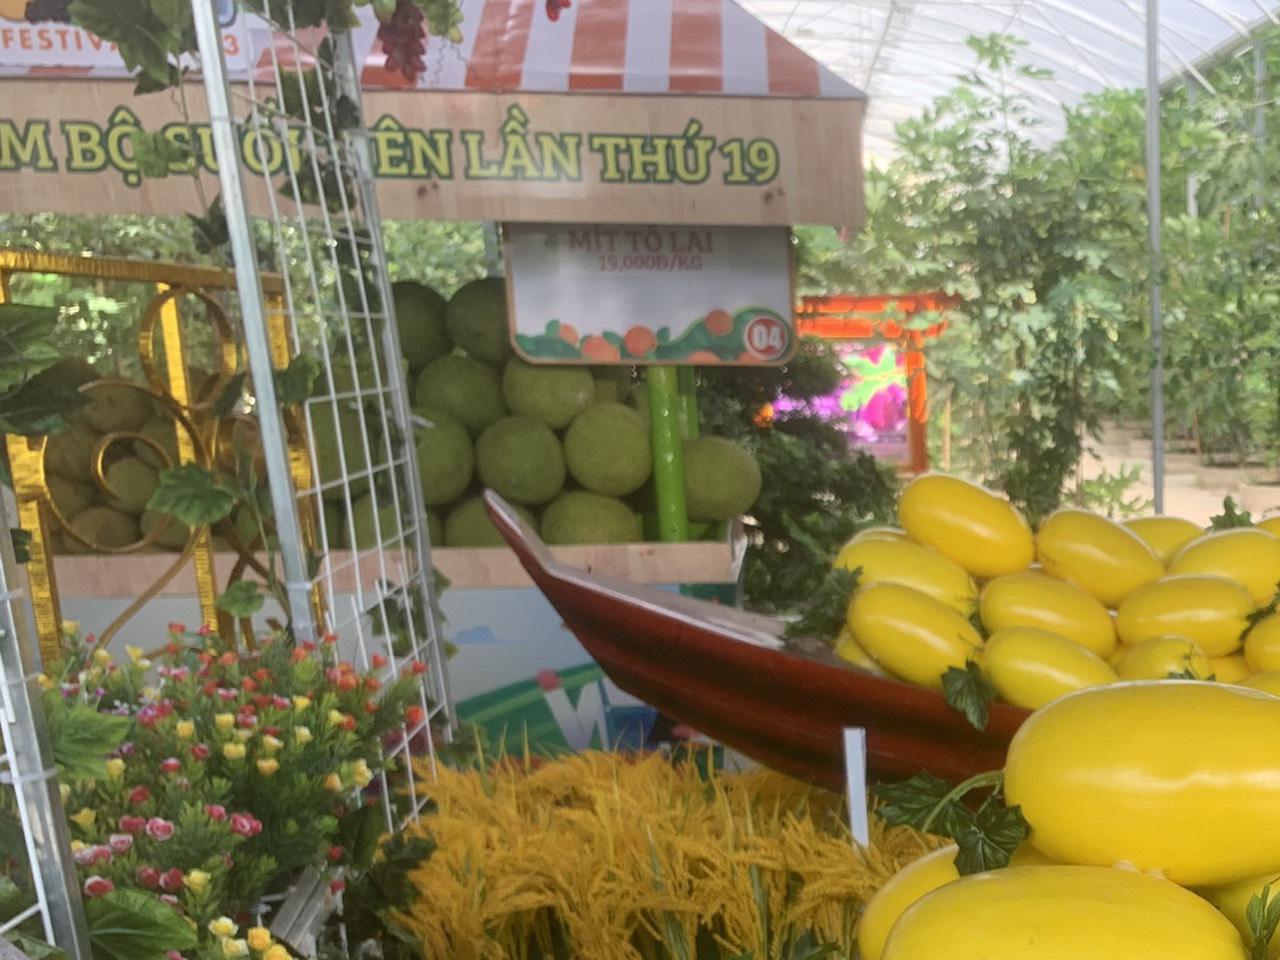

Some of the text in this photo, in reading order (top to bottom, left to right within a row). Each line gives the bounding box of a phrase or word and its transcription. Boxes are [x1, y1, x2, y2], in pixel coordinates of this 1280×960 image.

[1, 28, 119, 51] FESTIV
[371, 113, 453, 178] ÊN
[461, 104, 582, 181] LẦN
[589, 118, 715, 184] THỨ
[720, 137, 779, 185] 19
[752, 324, 782, 350] 04
